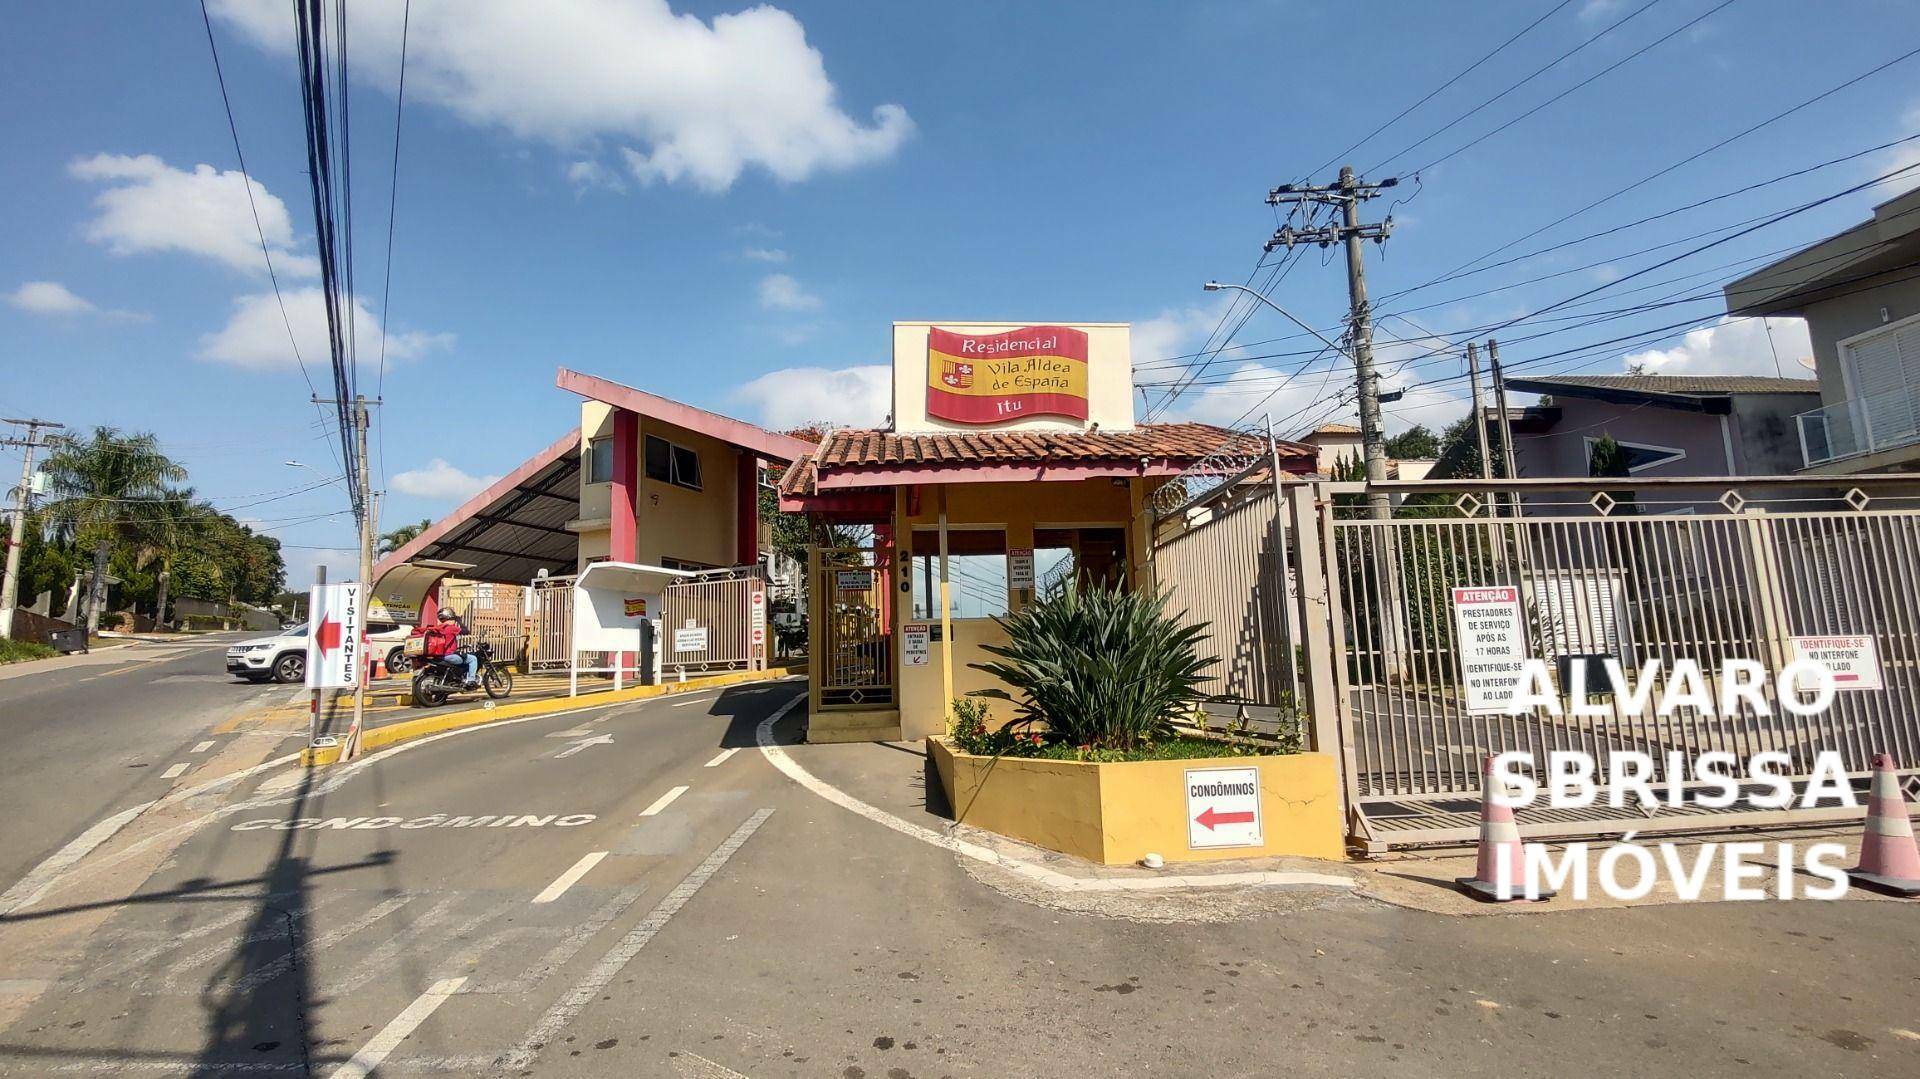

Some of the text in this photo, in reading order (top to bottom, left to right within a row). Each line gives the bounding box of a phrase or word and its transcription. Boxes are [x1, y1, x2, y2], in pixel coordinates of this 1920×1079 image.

[961, 336, 1057, 354] Residencial
[987, 358, 1071, 376] Vila Aldea
[992, 374, 1069, 390] de España
[996, 399, 1022, 415] Itu
[900, 550, 909, 593] 210
[1462, 590, 1509, 603] ATENÇÃO
[1462, 608, 1513, 618] PRESTADORES
[1468, 620, 1511, 631] DE SERVIÇO
[344, 588, 356, 682] VISITANTES
[1476, 631, 1507, 642] APÓS AS
[1800, 638, 1865, 649] IDENTIFIQUE-SE
[1475, 646, 1511, 656] 17 HORAS
[1808, 650, 1859, 660] NO INTERFONE
[1466, 662, 1523, 673] IDENTIFIQUE-SE
[1832, 662, 1851, 671] LADO
[1470, 677, 1521, 688] NO INTERFON
[1482, 690, 1513, 700] AO LADO
[1190, 780, 1255, 798] CONDÔMINOS
[230, 812, 597, 832] CONDÔMINO
